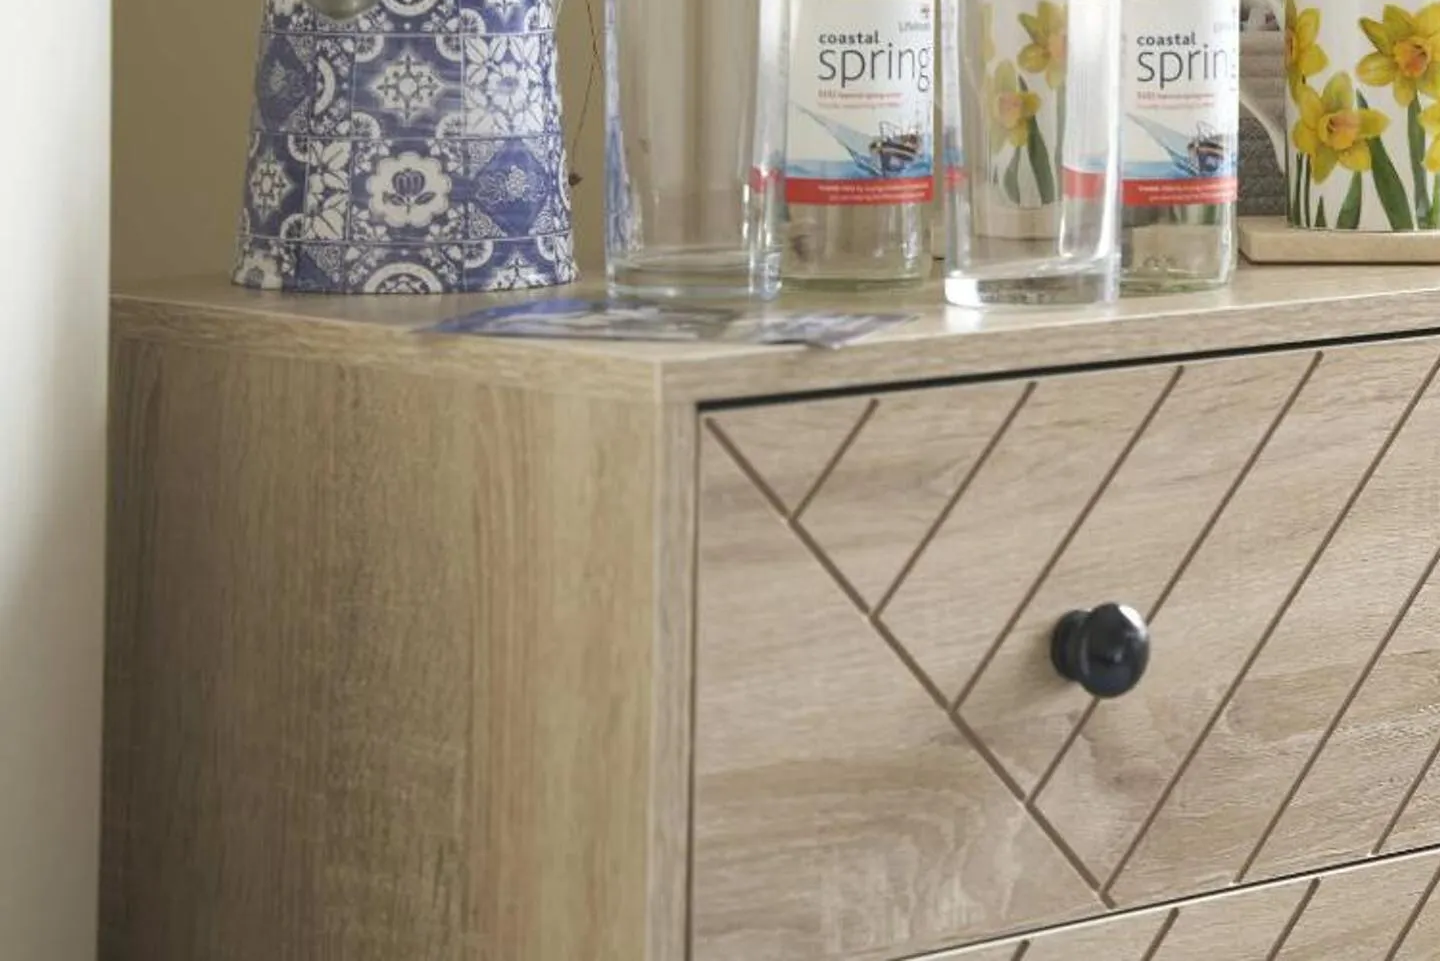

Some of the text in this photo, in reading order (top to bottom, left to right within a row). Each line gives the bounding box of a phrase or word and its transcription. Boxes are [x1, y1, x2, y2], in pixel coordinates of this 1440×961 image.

[818, 30, 879, 45] coastal
[1136, 32, 1196, 46] coastal
[818, 42, 931, 92] spring
[1136, 43, 1236, 91] sprin
